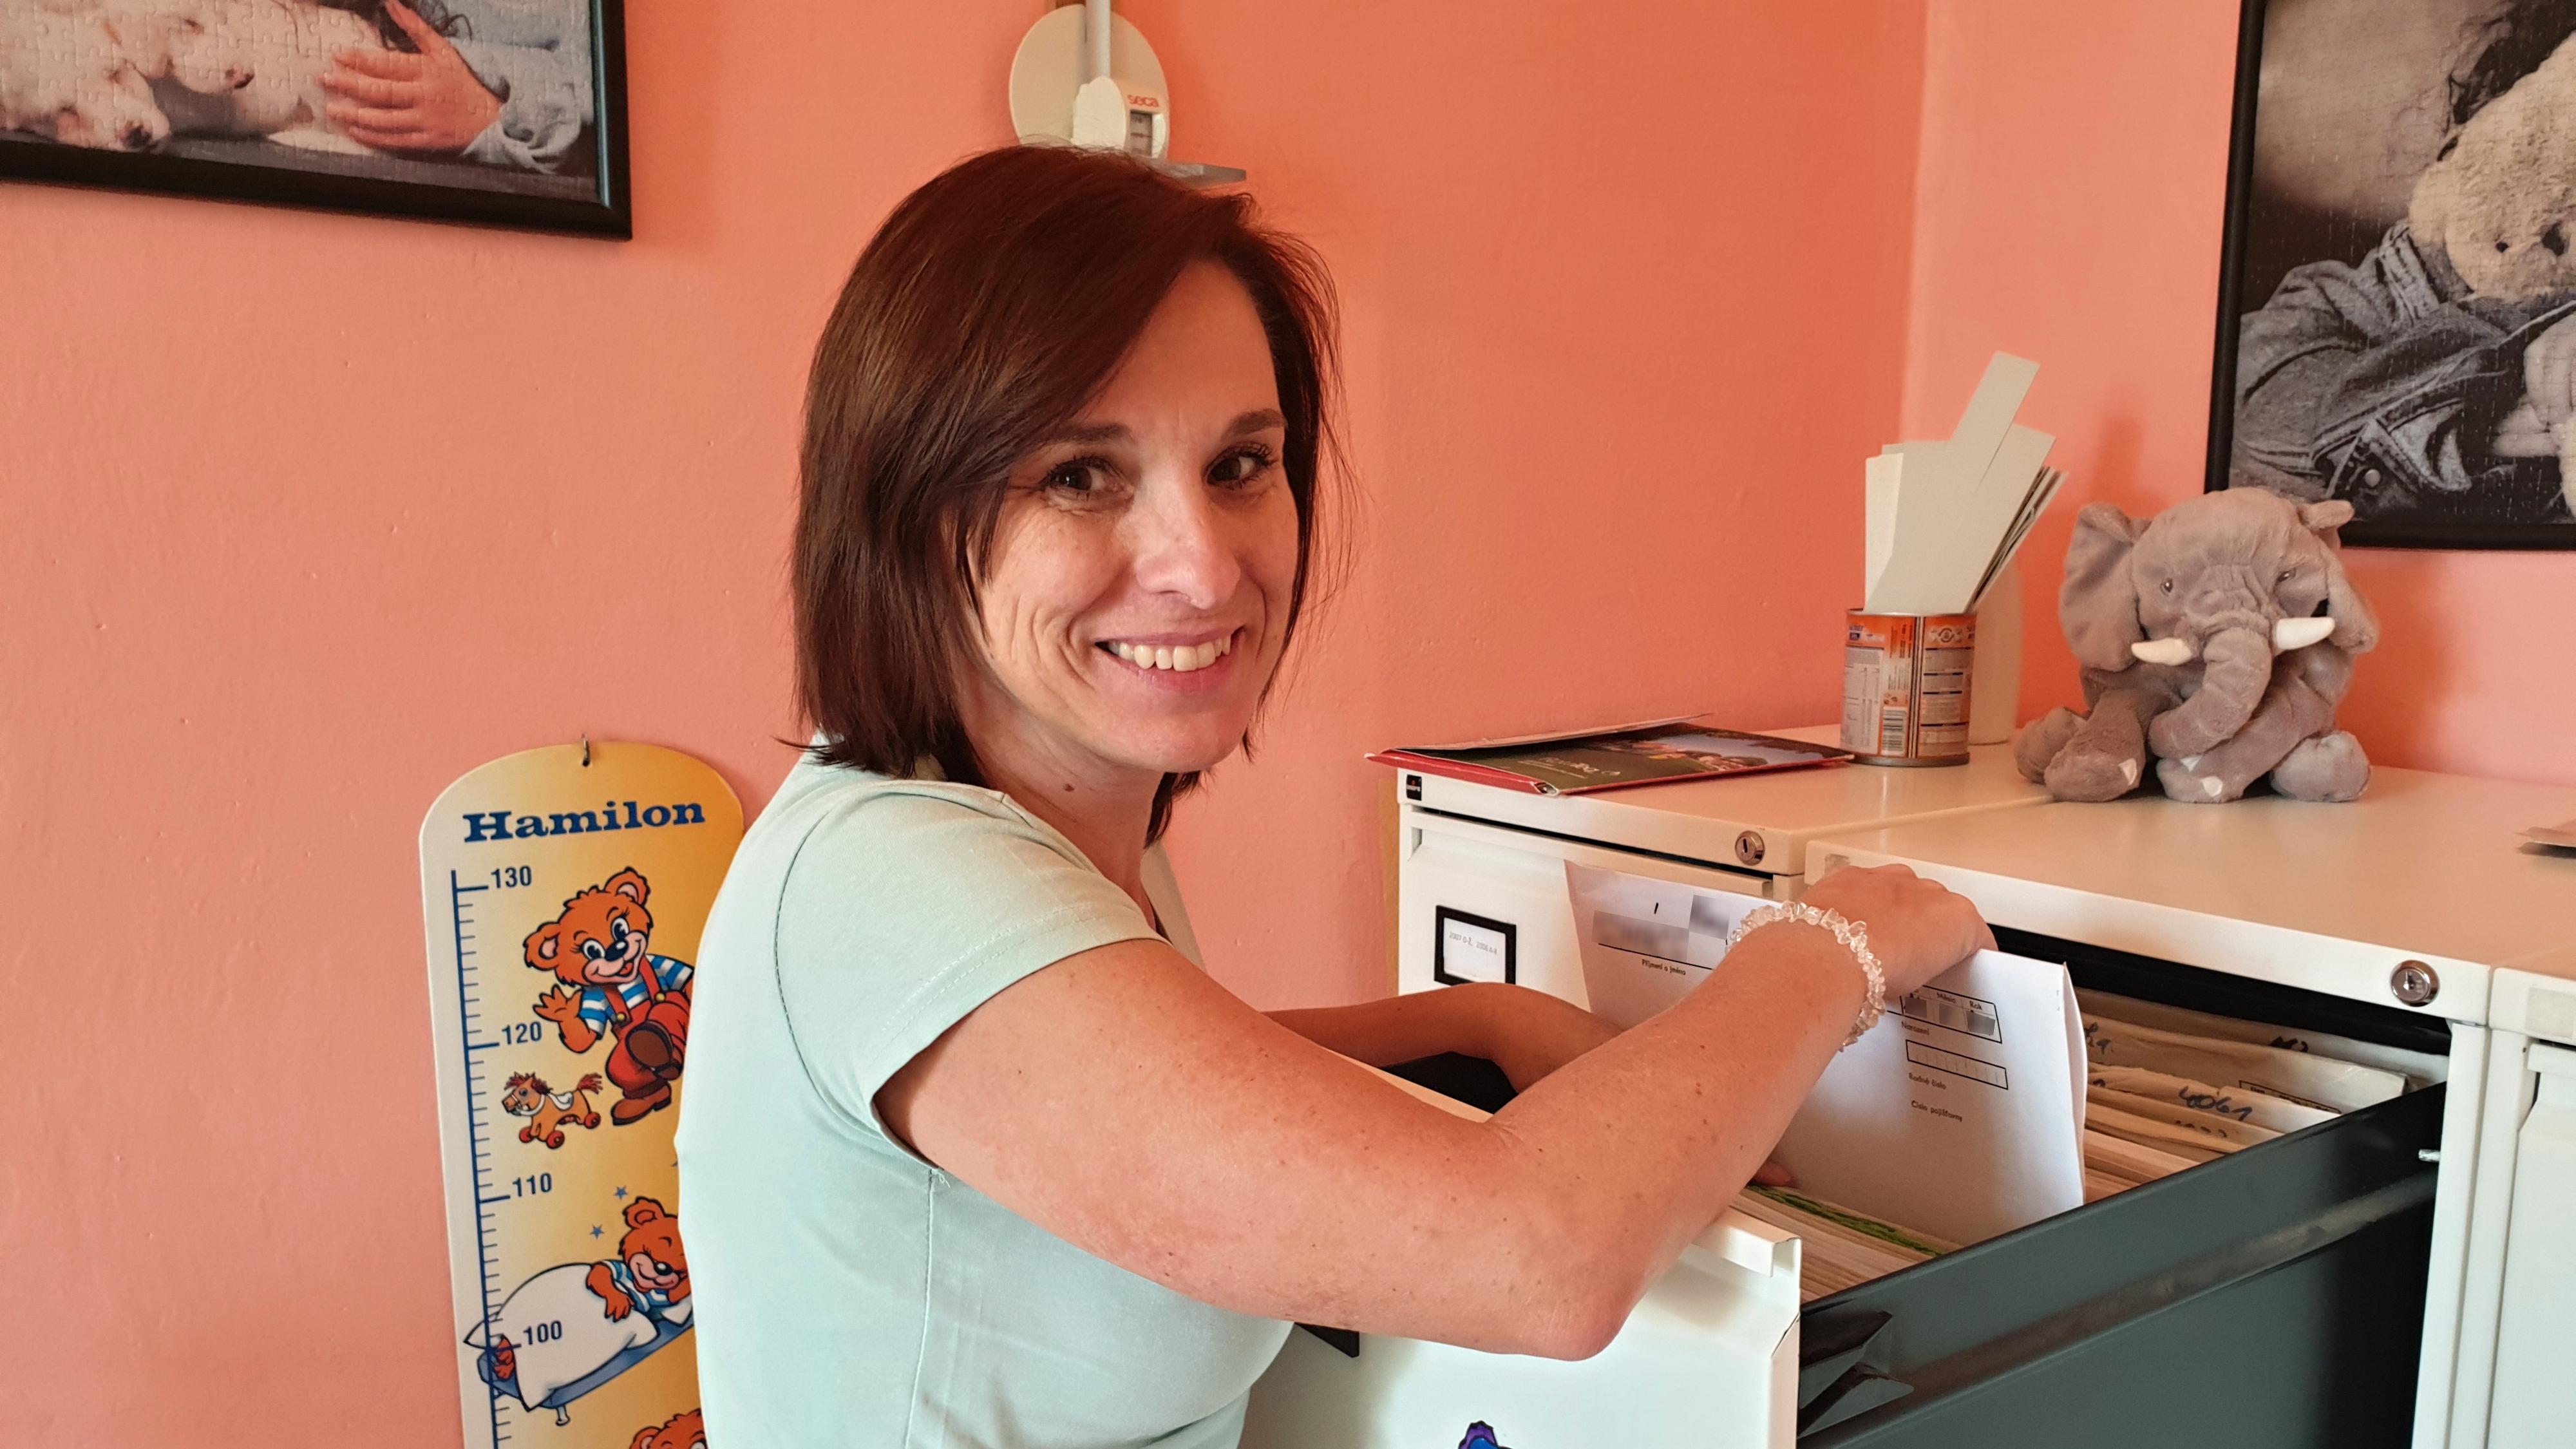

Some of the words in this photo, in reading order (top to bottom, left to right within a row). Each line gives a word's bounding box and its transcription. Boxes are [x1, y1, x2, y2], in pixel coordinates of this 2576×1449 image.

[462, 800, 706, 843] Hamilon
[491, 866, 533, 889] 130
[1969, 1000, 1983, 1010] Rok
[502, 1021, 542, 1045] 120
[512, 1172, 553, 1197] 110
[523, 1320, 562, 1345] 100
